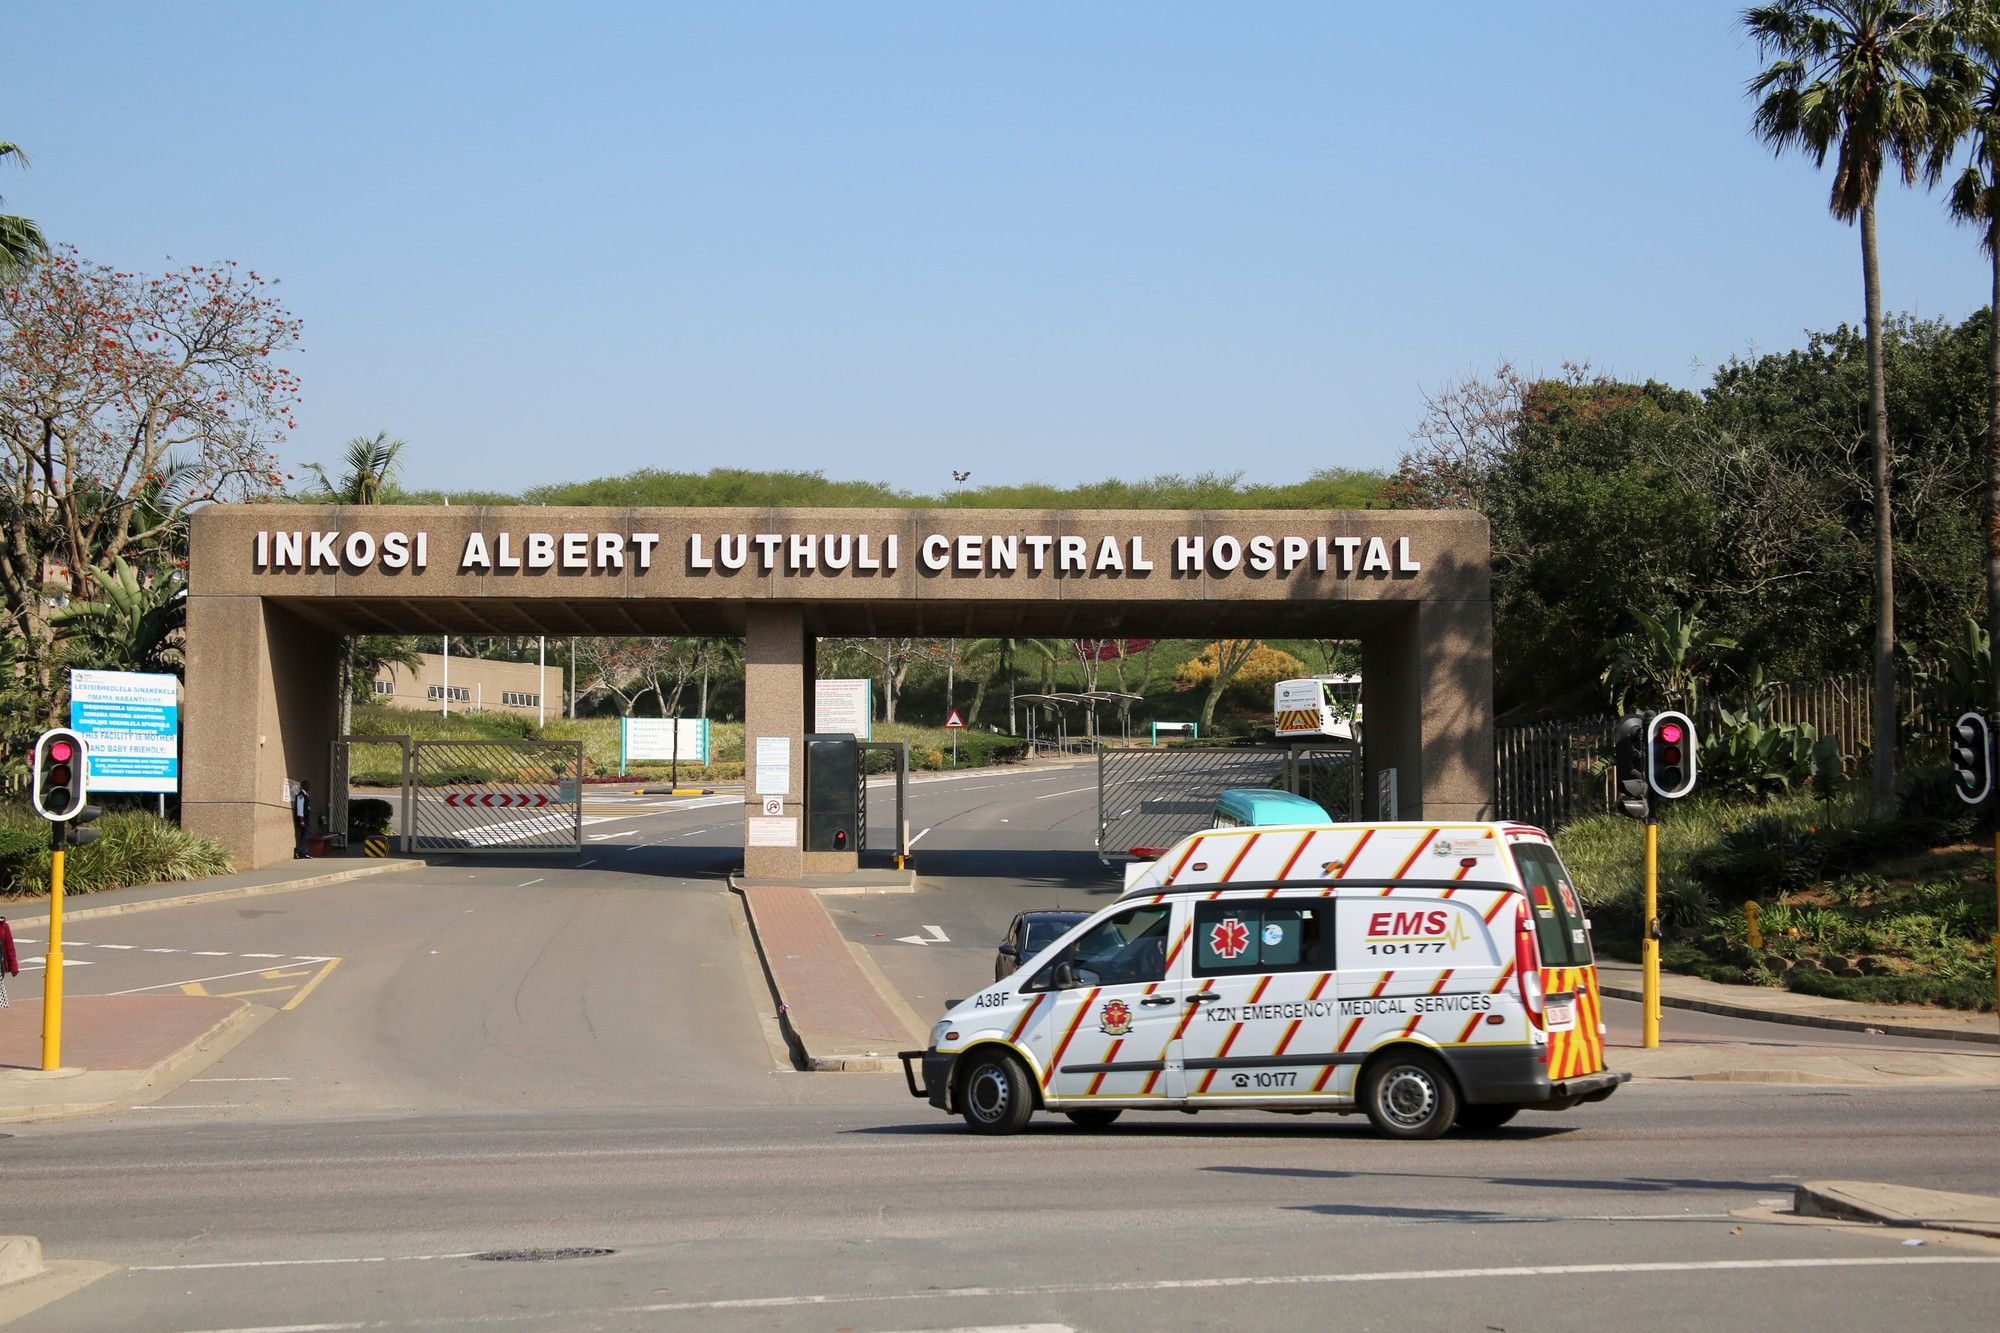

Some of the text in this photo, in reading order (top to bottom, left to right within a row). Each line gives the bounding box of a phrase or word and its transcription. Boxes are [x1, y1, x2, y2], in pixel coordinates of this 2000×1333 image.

[257, 531, 1421, 572] INKOSI ALBERT LUTHULI CENTRAL HOSPITAL
[82, 732, 175, 742] THIS FACILITY IS MOTHER
[90, 744, 105, 752] AND
[107, 745, 127, 753] BABY
[1367, 911, 1448, 936] EMS
[1366, 943, 1446, 955] 10177
[975, 992, 1010, 1008] A38F
[1206, 995, 1491, 1022] KZN EMERGENCY MEDICAL SERVICES
[1253, 1072, 1297, 1087] 10177
